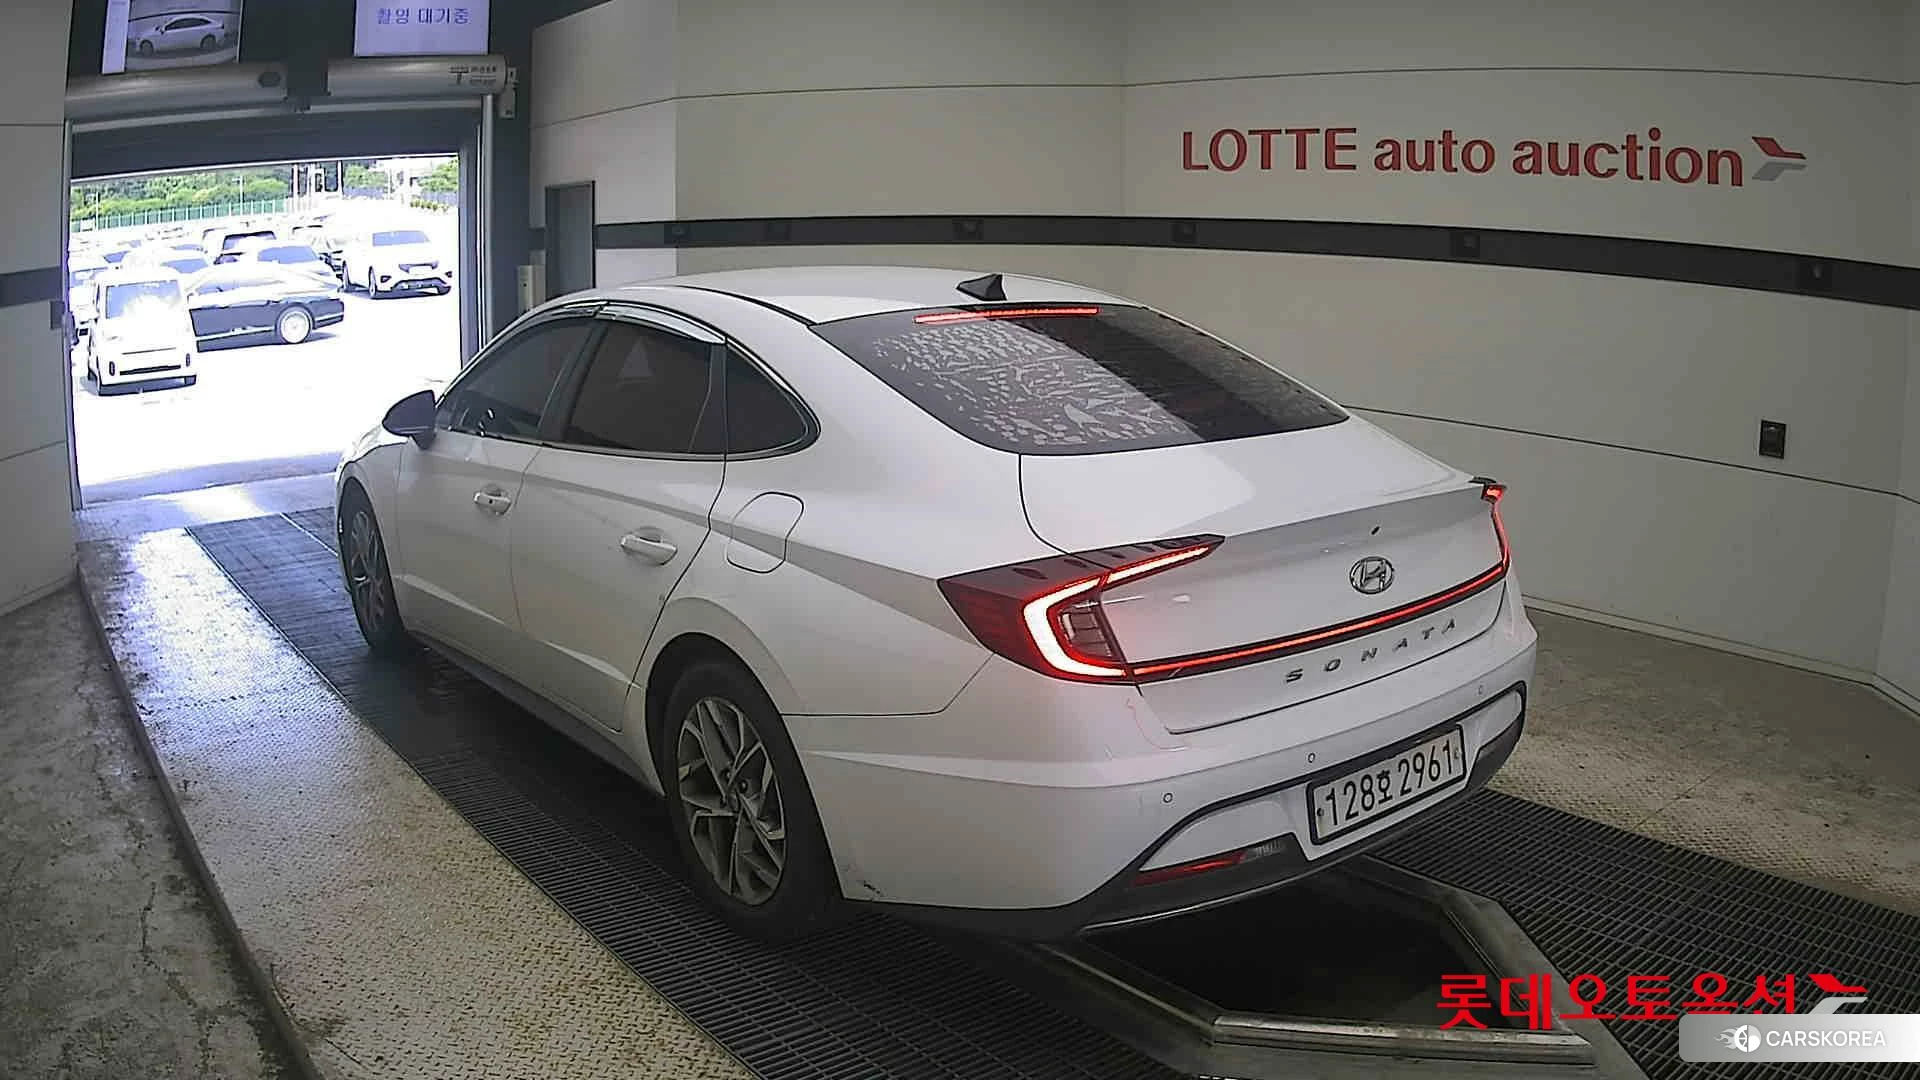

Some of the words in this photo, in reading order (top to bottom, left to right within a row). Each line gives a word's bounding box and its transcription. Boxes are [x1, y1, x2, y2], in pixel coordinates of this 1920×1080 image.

[418, 8, 470, 25] 대기중
[1182, 127, 1357, 172] LOTTE
[1374, 129, 1496, 173] auto
[1512, 127, 1744, 187] auction
[1285, 618, 1456, 683] SONATA
[1398, 739, 1453, 797] 2961
